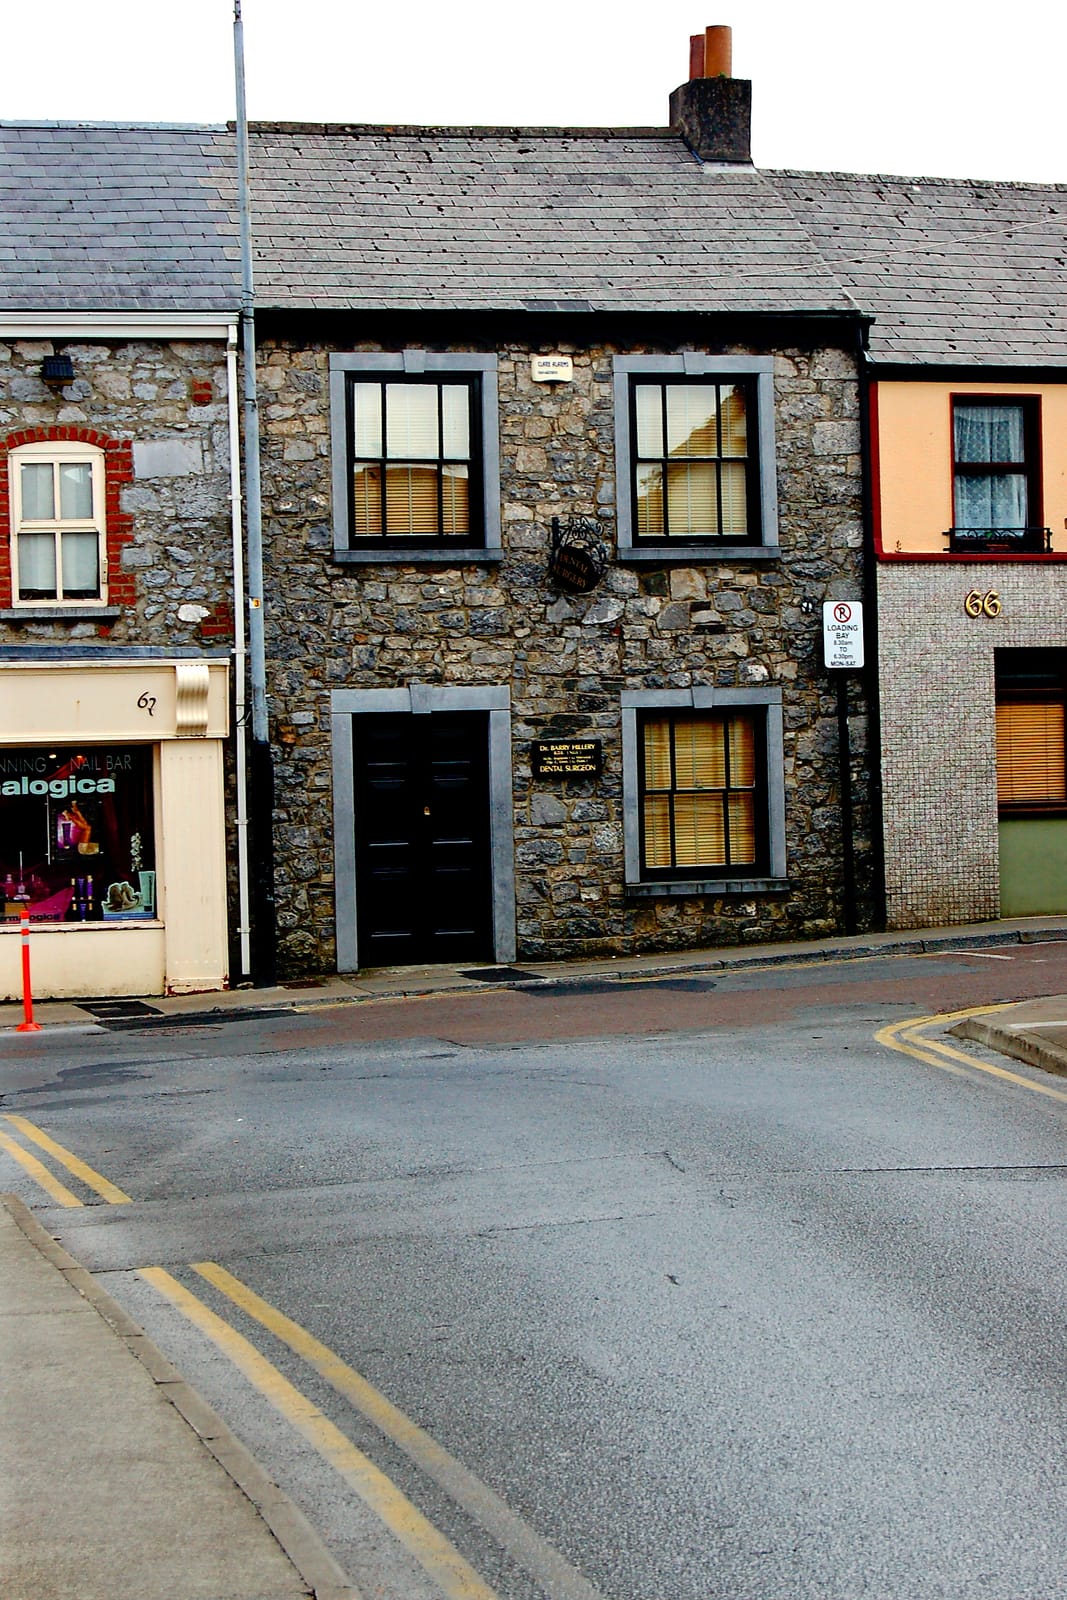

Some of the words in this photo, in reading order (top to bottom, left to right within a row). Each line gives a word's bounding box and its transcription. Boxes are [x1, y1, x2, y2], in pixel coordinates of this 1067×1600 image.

[965, 590, 1001, 618] 66
[137, 691, 157, 717] 67
[70, 757, 101, 771] NAIL
[106, 755, 132, 770] BAR
[0, 775, 115, 799] alogica
